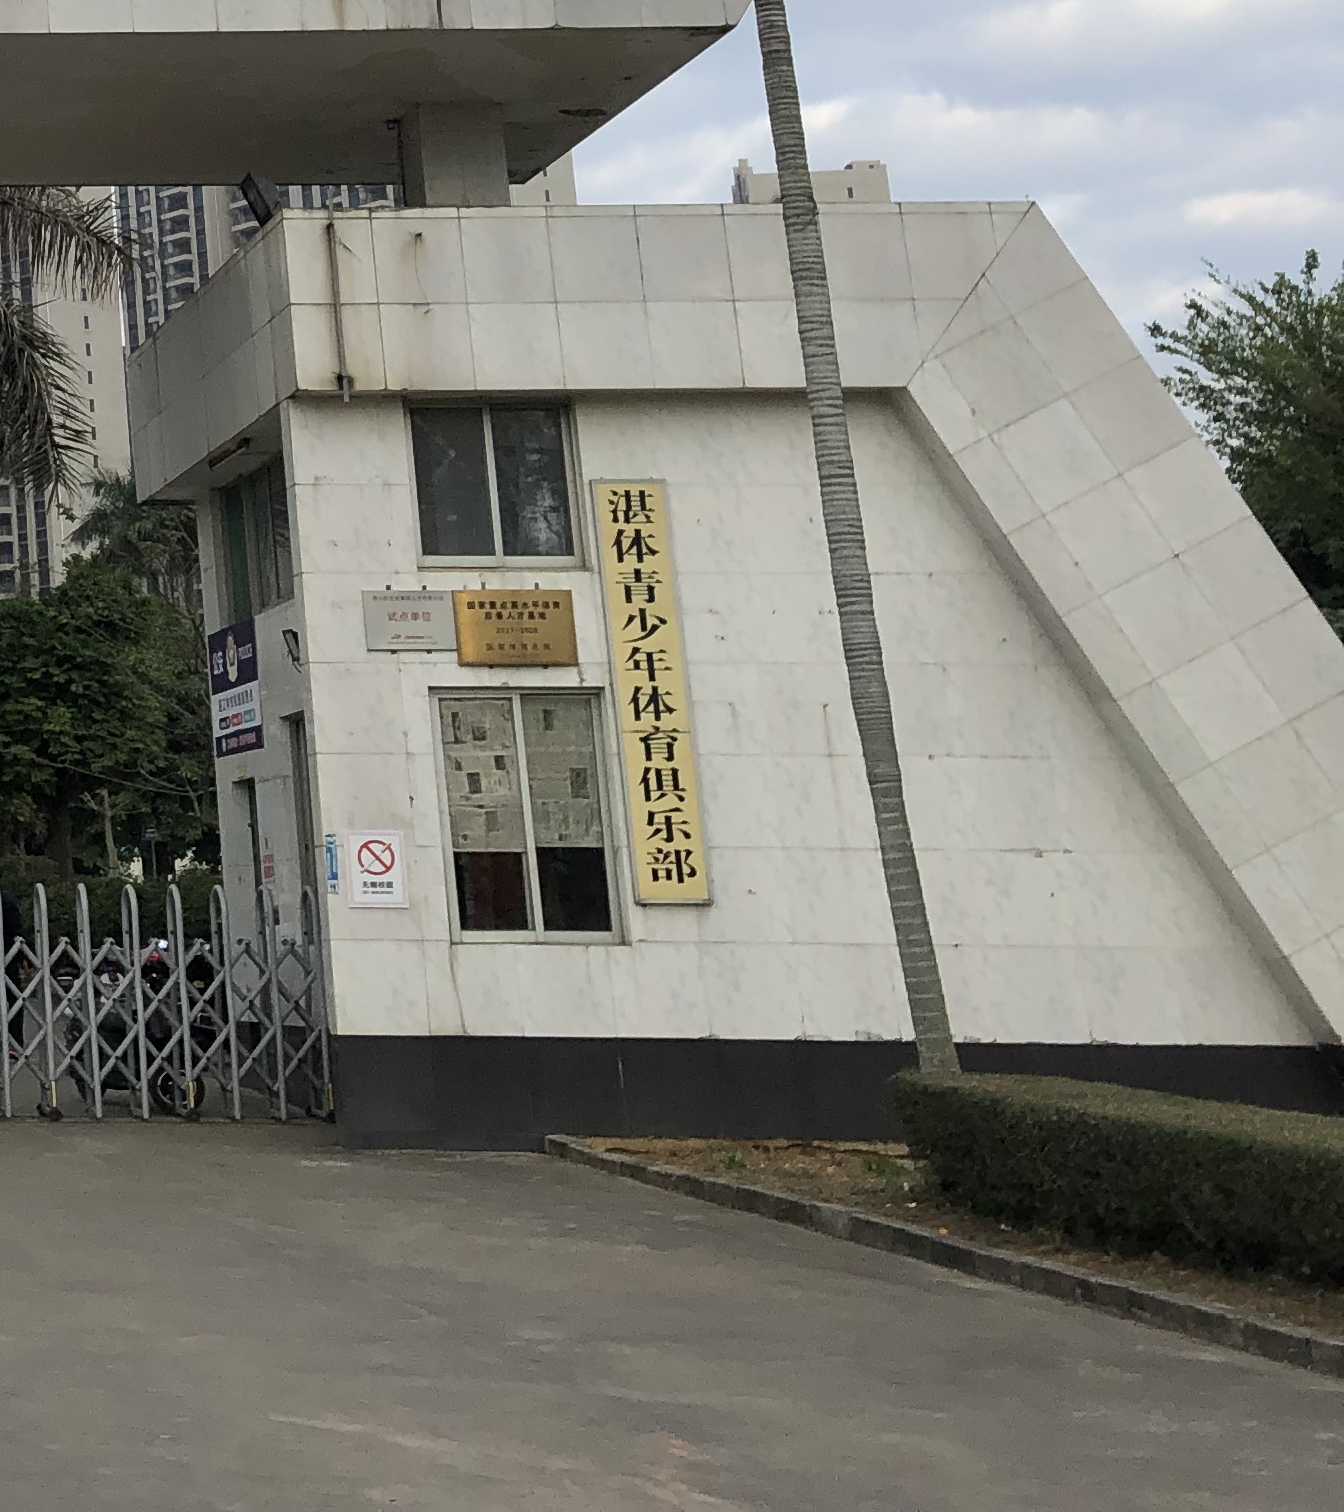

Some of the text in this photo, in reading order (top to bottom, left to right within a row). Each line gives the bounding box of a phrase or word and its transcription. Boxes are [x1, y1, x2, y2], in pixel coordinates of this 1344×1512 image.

[607, 489, 698, 884] 湛体青少年体育俱乐部
